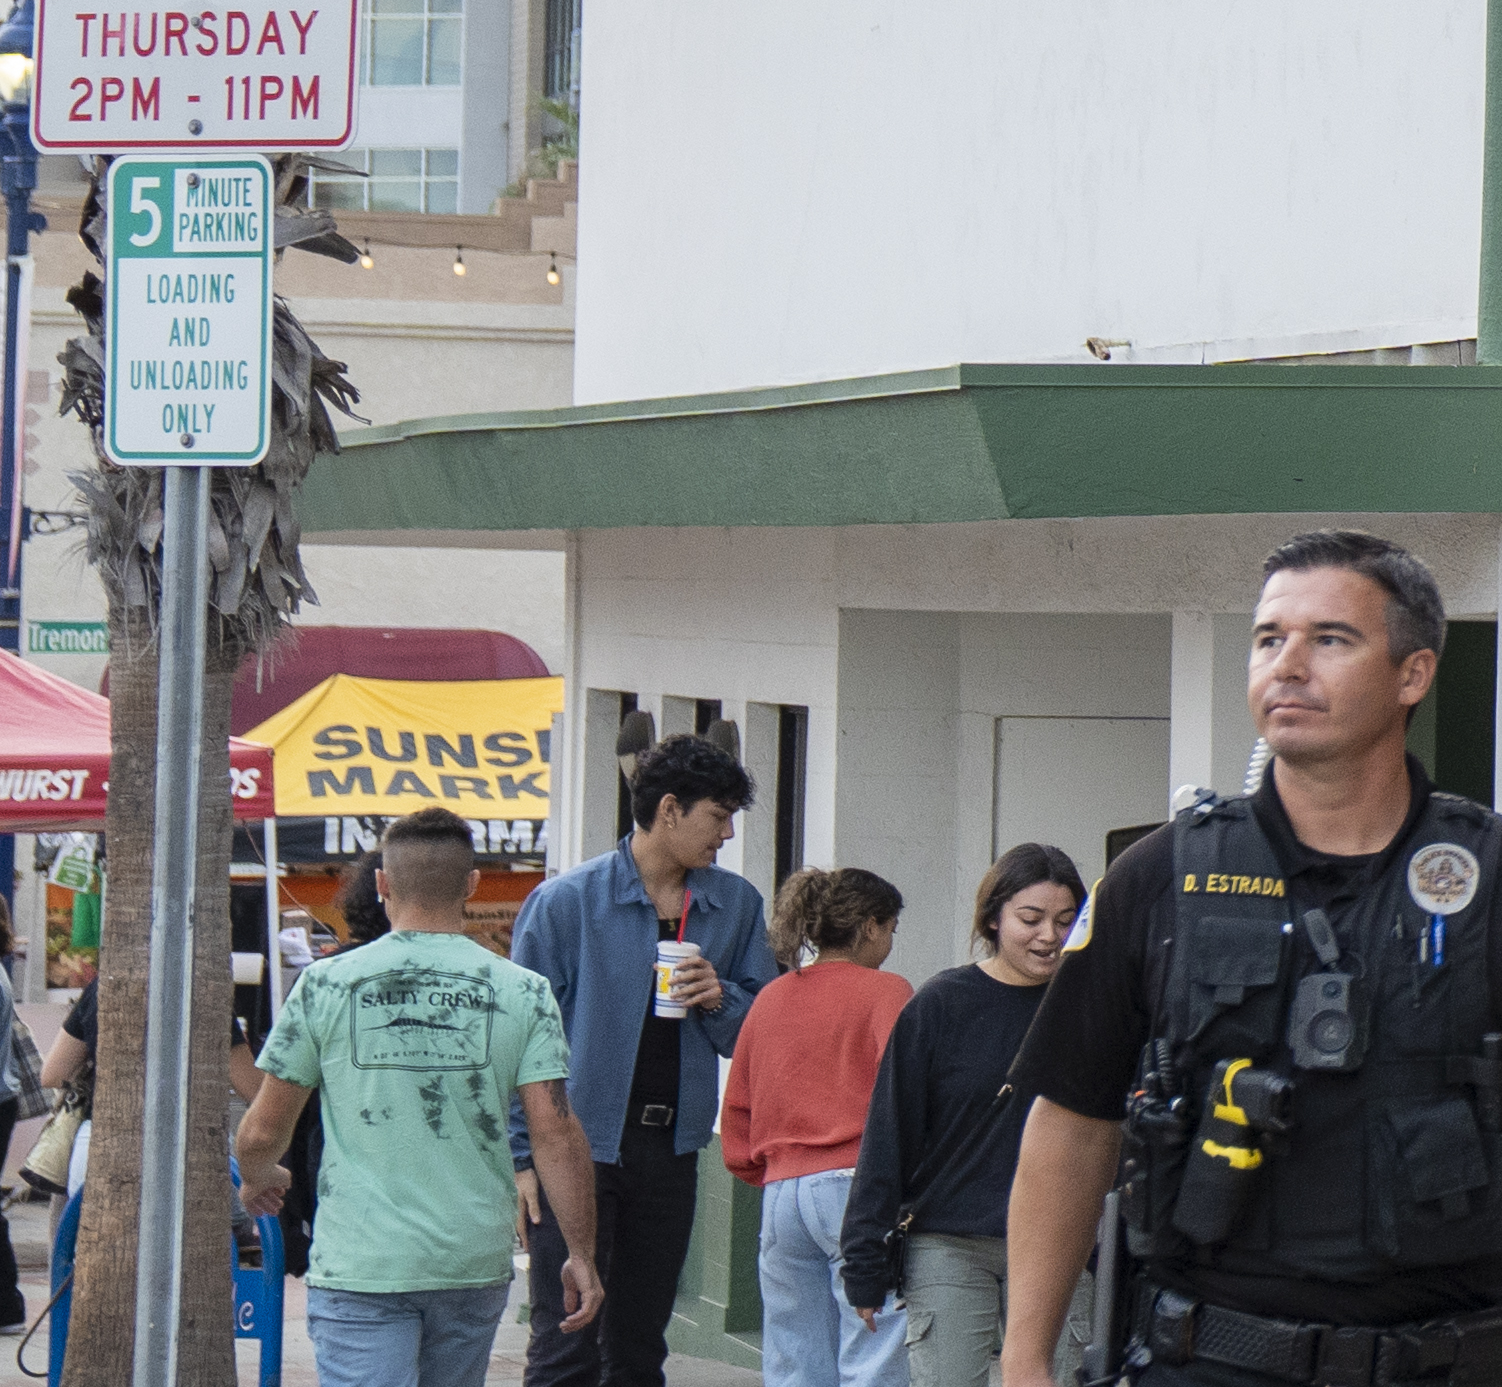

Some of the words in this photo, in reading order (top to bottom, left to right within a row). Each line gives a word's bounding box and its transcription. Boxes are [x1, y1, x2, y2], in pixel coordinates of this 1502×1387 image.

[75, 10, 320, 58] THURSDAY
[69, 76, 161, 122] 2PM
[224, 75, 321, 121] 11PM
[186, 177, 253, 208] MINUTE
[128, 176, 162, 248] 5
[179, 211, 259, 243] PARKING
[146, 273, 236, 305] LOADING
[169, 317, 211, 348] AND
[130, 359, 249, 391] UNLOADING
[162, 403, 215, 435] ONLY
[1183, 873, 1200, 893] D.
[1205, 873, 1285, 898] ESTRADA
[361, 990, 418, 1008] SALTY
[428, 992, 484, 1009] CREW
